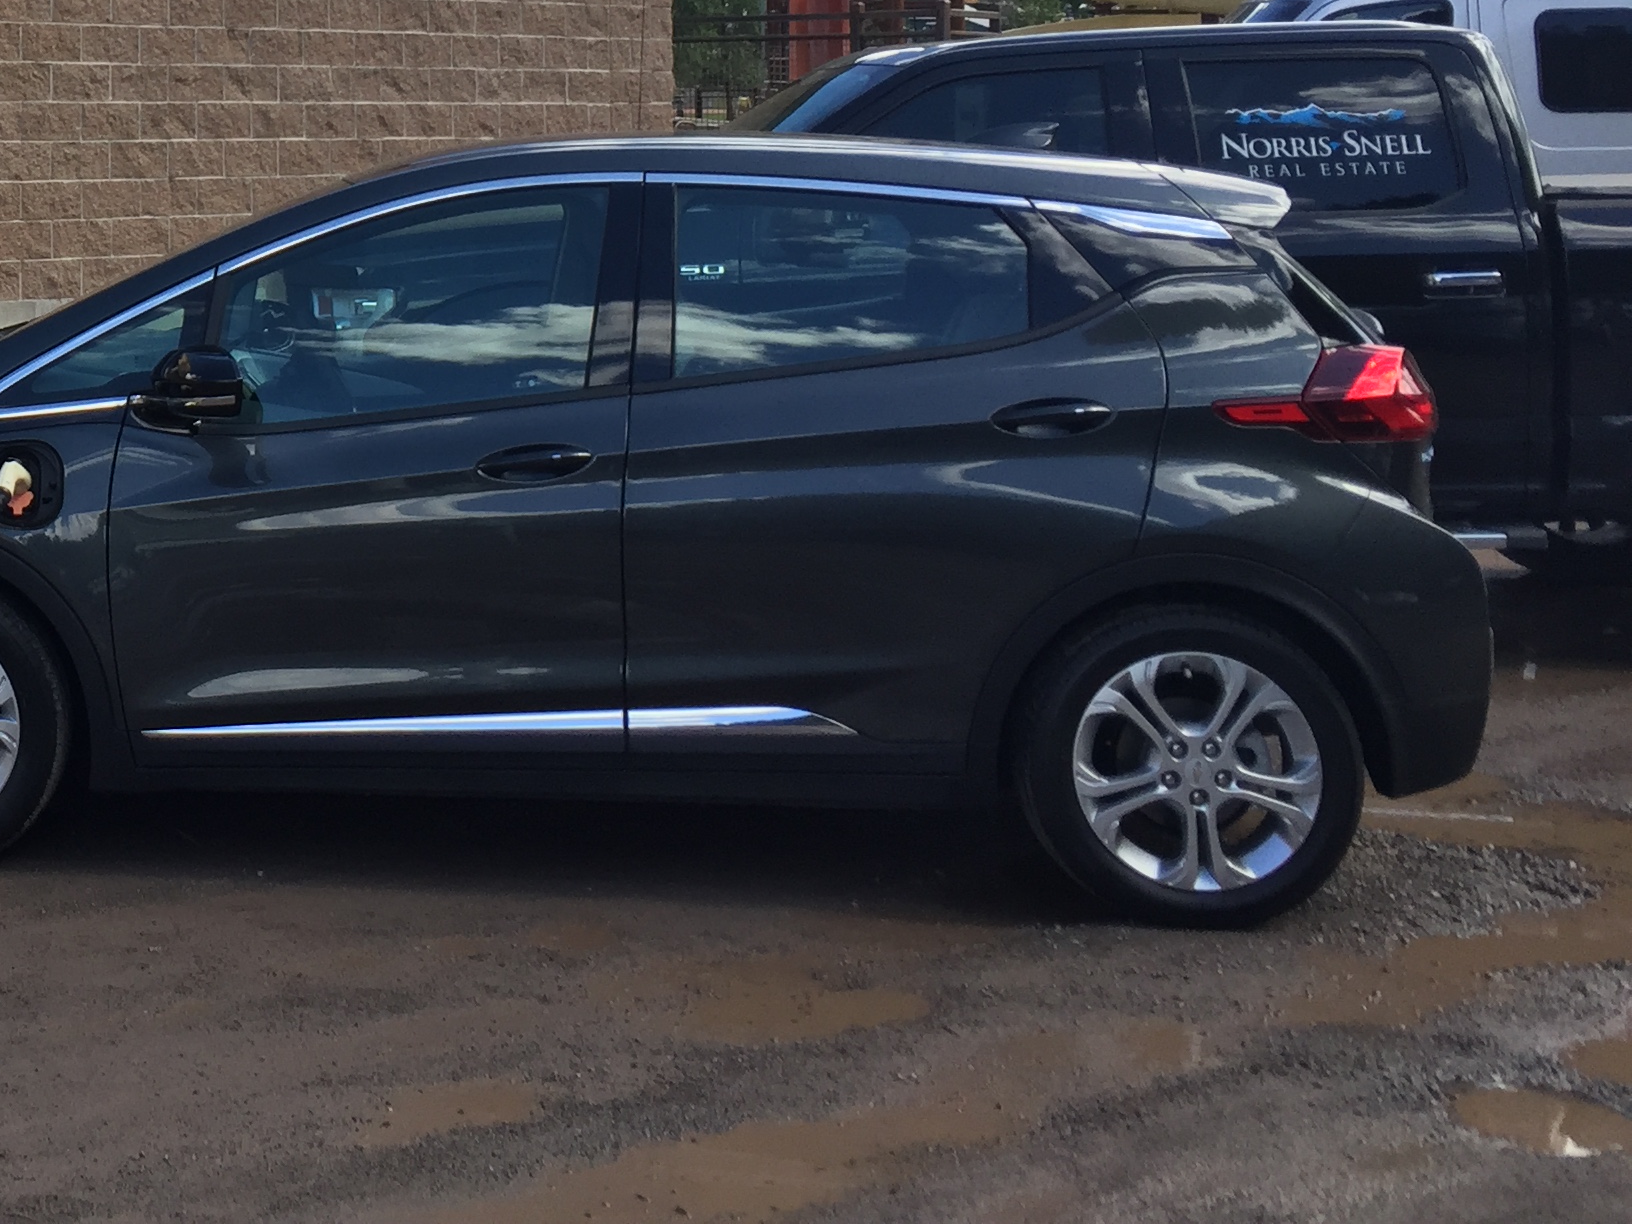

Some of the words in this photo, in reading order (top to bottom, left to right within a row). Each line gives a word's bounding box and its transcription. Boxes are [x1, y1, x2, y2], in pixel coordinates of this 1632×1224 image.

[1220, 132, 1333, 160] NORRIS
[1342, 129, 1432, 156] SNELL
[1248, 162, 1306, 178] REAL
[1319, 160, 1407, 176] ESTATE
